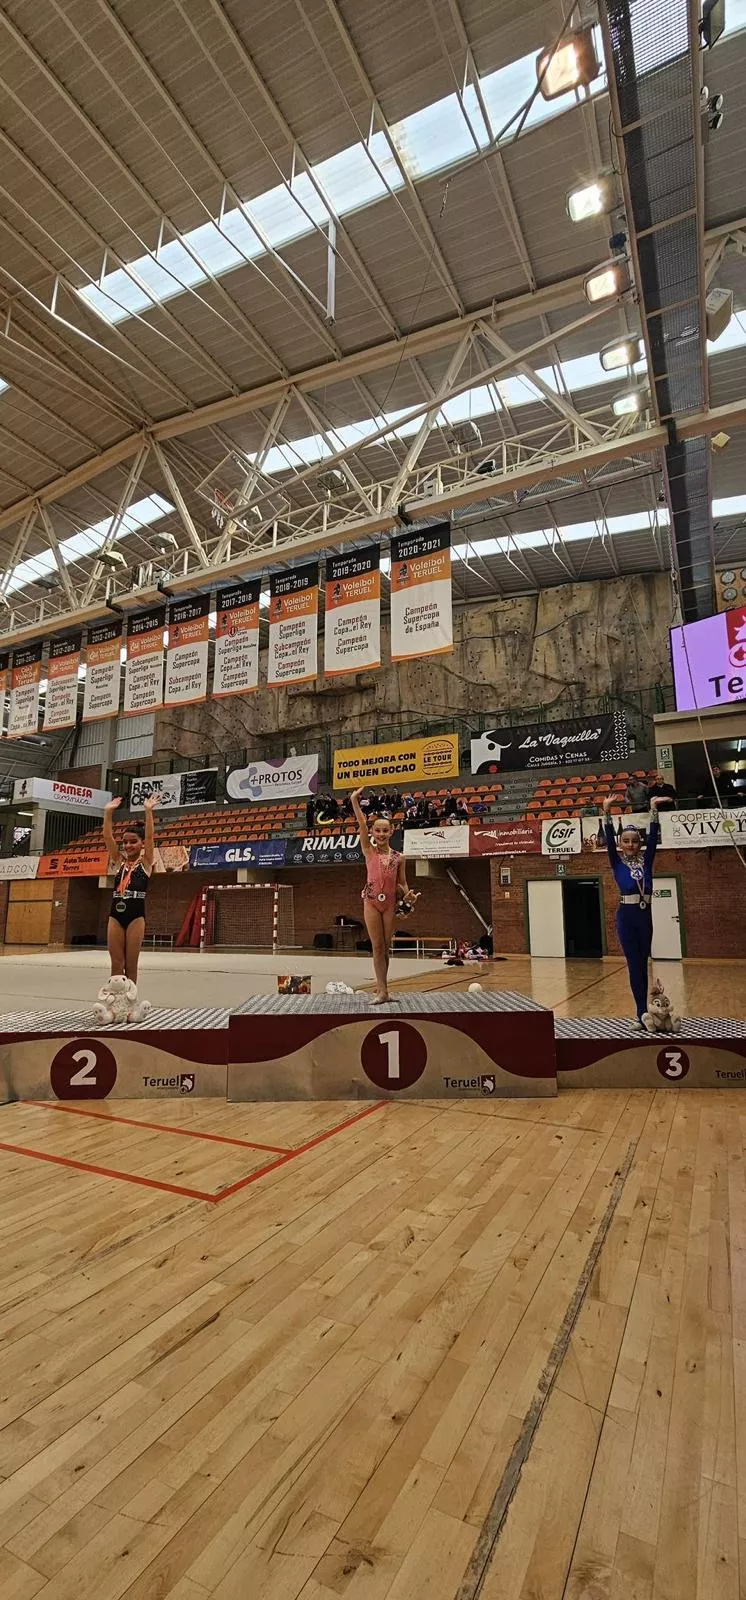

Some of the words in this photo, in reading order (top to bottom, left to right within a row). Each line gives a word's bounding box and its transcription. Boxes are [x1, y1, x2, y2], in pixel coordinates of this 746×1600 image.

[398, 536, 424, 548] Temporada
[398, 538, 441, 558] 2020-2021
[332, 557, 356, 568] Temporada
[332, 560, 372, 578] 2019-2020
[410, 556, 445, 572] Voleibol
[414, 566, 442, 578] TERUEL
[276, 578, 308, 594] 2018-2019
[343, 577, 376, 592] Voleibol
[346, 586, 372, 598] TERUEL
[222, 593, 252, 608] 2017-2018
[284, 593, 312, 606] Voleibol
[286, 602, 310, 612] TERUEL
[405, 602, 438, 616] Campeón
[174, 608, 202, 621] 2016-2017
[229, 608, 256, 620] Voleibol
[232, 616, 254, 625] TERUEL
[338, 614, 368, 626] Campeón
[404, 612, 440, 625] Supercopa
[132, 618, 158, 632] 2014-2015
[180, 622, 205, 634] Voleibol
[280, 620, 306, 633] Campeón
[334, 626, 348, 635] Copa
[352, 623, 358, 631] el
[360, 621, 372, 630] Rey
[405, 626, 414, 634] de
[415, 620, 440, 632] España
[279, 629, 306, 640] Superliga
[338, 634, 366, 646] Campeón
[218, 644, 242, 655] Superliga
[274, 638, 311, 652] Subcampeón
[336, 643, 368, 654] Supercopa
[274, 650, 288, 660] Copa
[292, 648, 298, 656] el
[299, 646, 309, 654] Rey
[220, 663, 232, 672] Copa
[278, 658, 304, 670] Campeón
[275, 666, 306, 678] Supercopa
[518, 736, 538, 749] La
[542, 728, 600, 748] Vaquilla
[338, 760, 360, 768] TODO
[361, 756, 396, 766] MEJORA
[398, 752, 416, 760] CON
[432, 754, 452, 762] TOUR
[337, 771, 350, 780] UN
[352, 768, 378, 778] BUEN
[381, 764, 416, 774] BOCAO
[52, 782, 92, 798] PAMESA
[552, 828, 576, 839] CSIF
[378, 1030, 400, 1078] 1
[69, 1049, 98, 1086] 2
[665, 1052, 683, 1076] 3
[715, 1070, 744, 1079] Teruel
[143, 1075, 180, 1088] Teruel
[444, 1076, 480, 1089] Teruel
